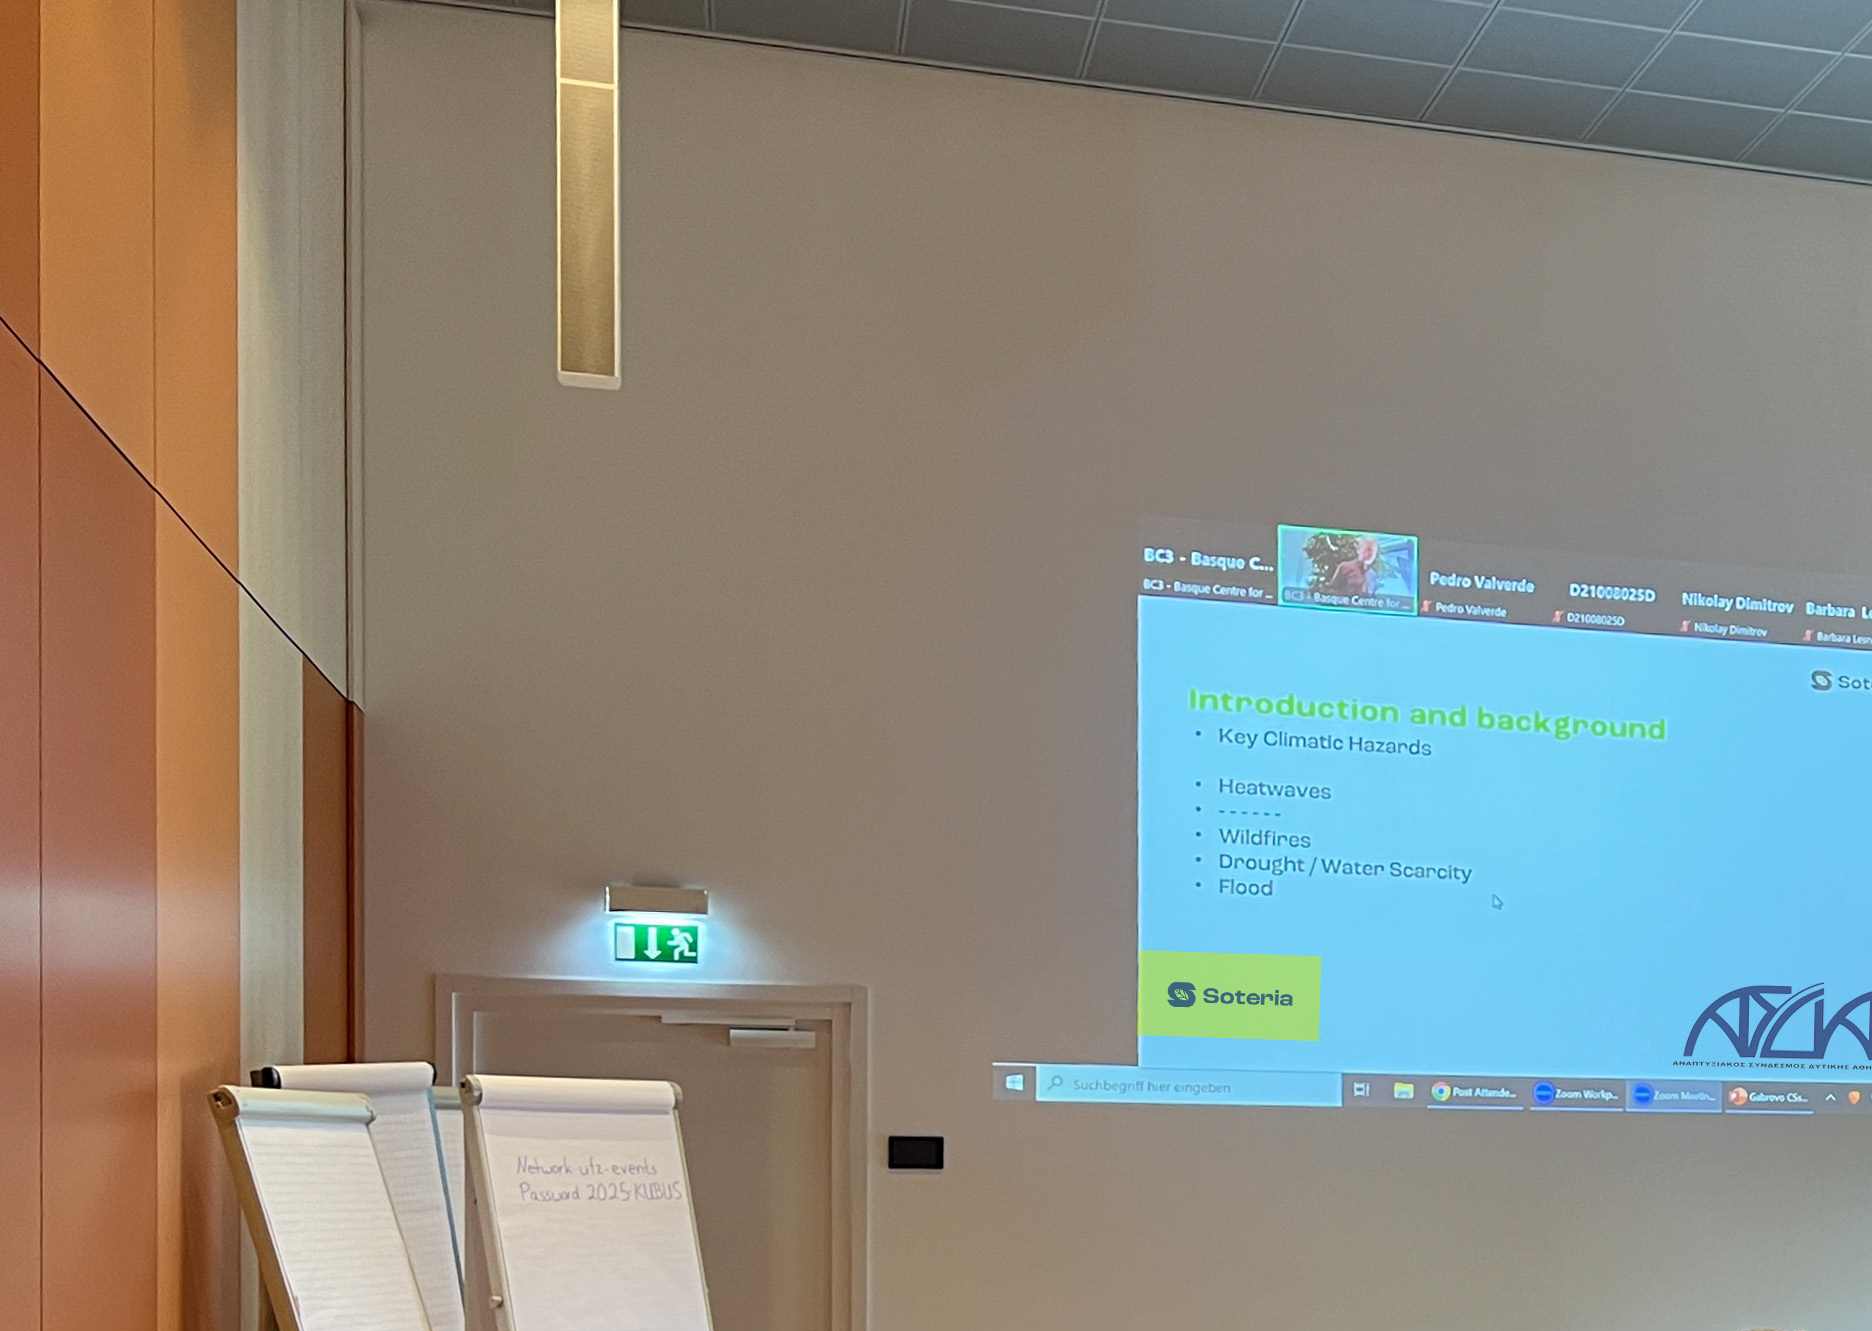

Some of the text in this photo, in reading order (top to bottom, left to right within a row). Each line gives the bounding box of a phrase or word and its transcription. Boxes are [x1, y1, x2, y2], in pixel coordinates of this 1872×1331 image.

[1143, 547, 1175, 563] BC3
[1143, 578, 1164, 590] BC3
[1173, 580, 1211, 595] Basque
[1212, 583, 1248, 597] Centre
[1249, 586, 1263, 598] for
[1430, 571, 1535, 593] Pedro Valverde
[1351, 594, 1385, 609] Centre
[1435, 601, 1507, 618] Pedro Valverde
[1682, 592, 1794, 614] Nikolay Dimitrov
[1806, 602, 1855, 618] Barbara
[1694, 622, 1767, 638] Nikolay Dimitrov
[1817, 631, 1851, 644] Barbara
[1189, 687, 1666, 741] Introduction and background
[1219, 728, 1432, 757] Key Climatic Hazards
[1219, 778, 1332, 800] Heatwaves
[1219, 828, 1312, 849] Wildfires
[1219, 854, 1305, 876] Drought
[1321, 858, 1385, 876] Water
[1390, 861, 1473, 885] Scarcity
[1219, 878, 1274, 896] Flood
[1202, 988, 1294, 1007] Soteria
[1073, 1079, 1232, 1097] Suchbegriff hier eingeben
[1555, 1087, 1582, 1100] Zoom
[520, 1182, 580, 1201] Password
